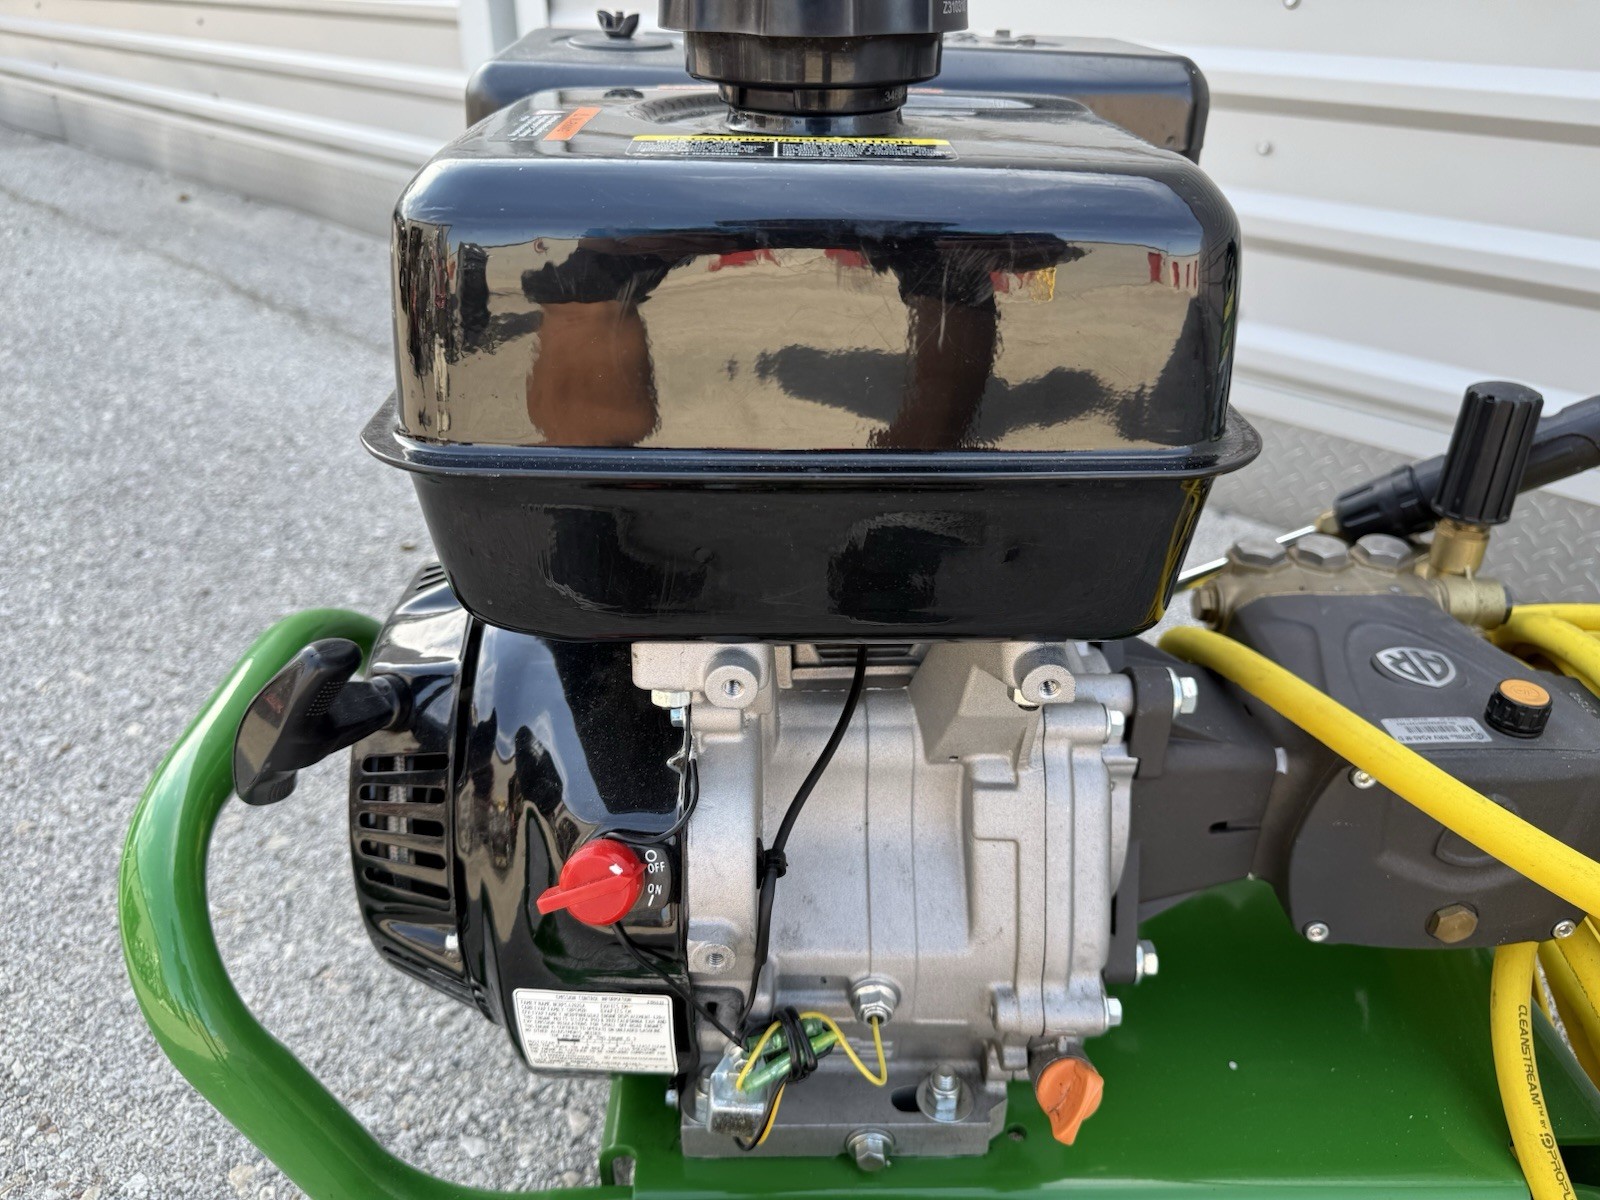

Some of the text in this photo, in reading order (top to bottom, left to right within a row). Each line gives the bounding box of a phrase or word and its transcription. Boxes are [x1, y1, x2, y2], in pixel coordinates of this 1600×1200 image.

[647, 861, 665, 874] OFF
[647, 883, 662, 895] ON
[1539, 1118, 1547, 1130] BY
